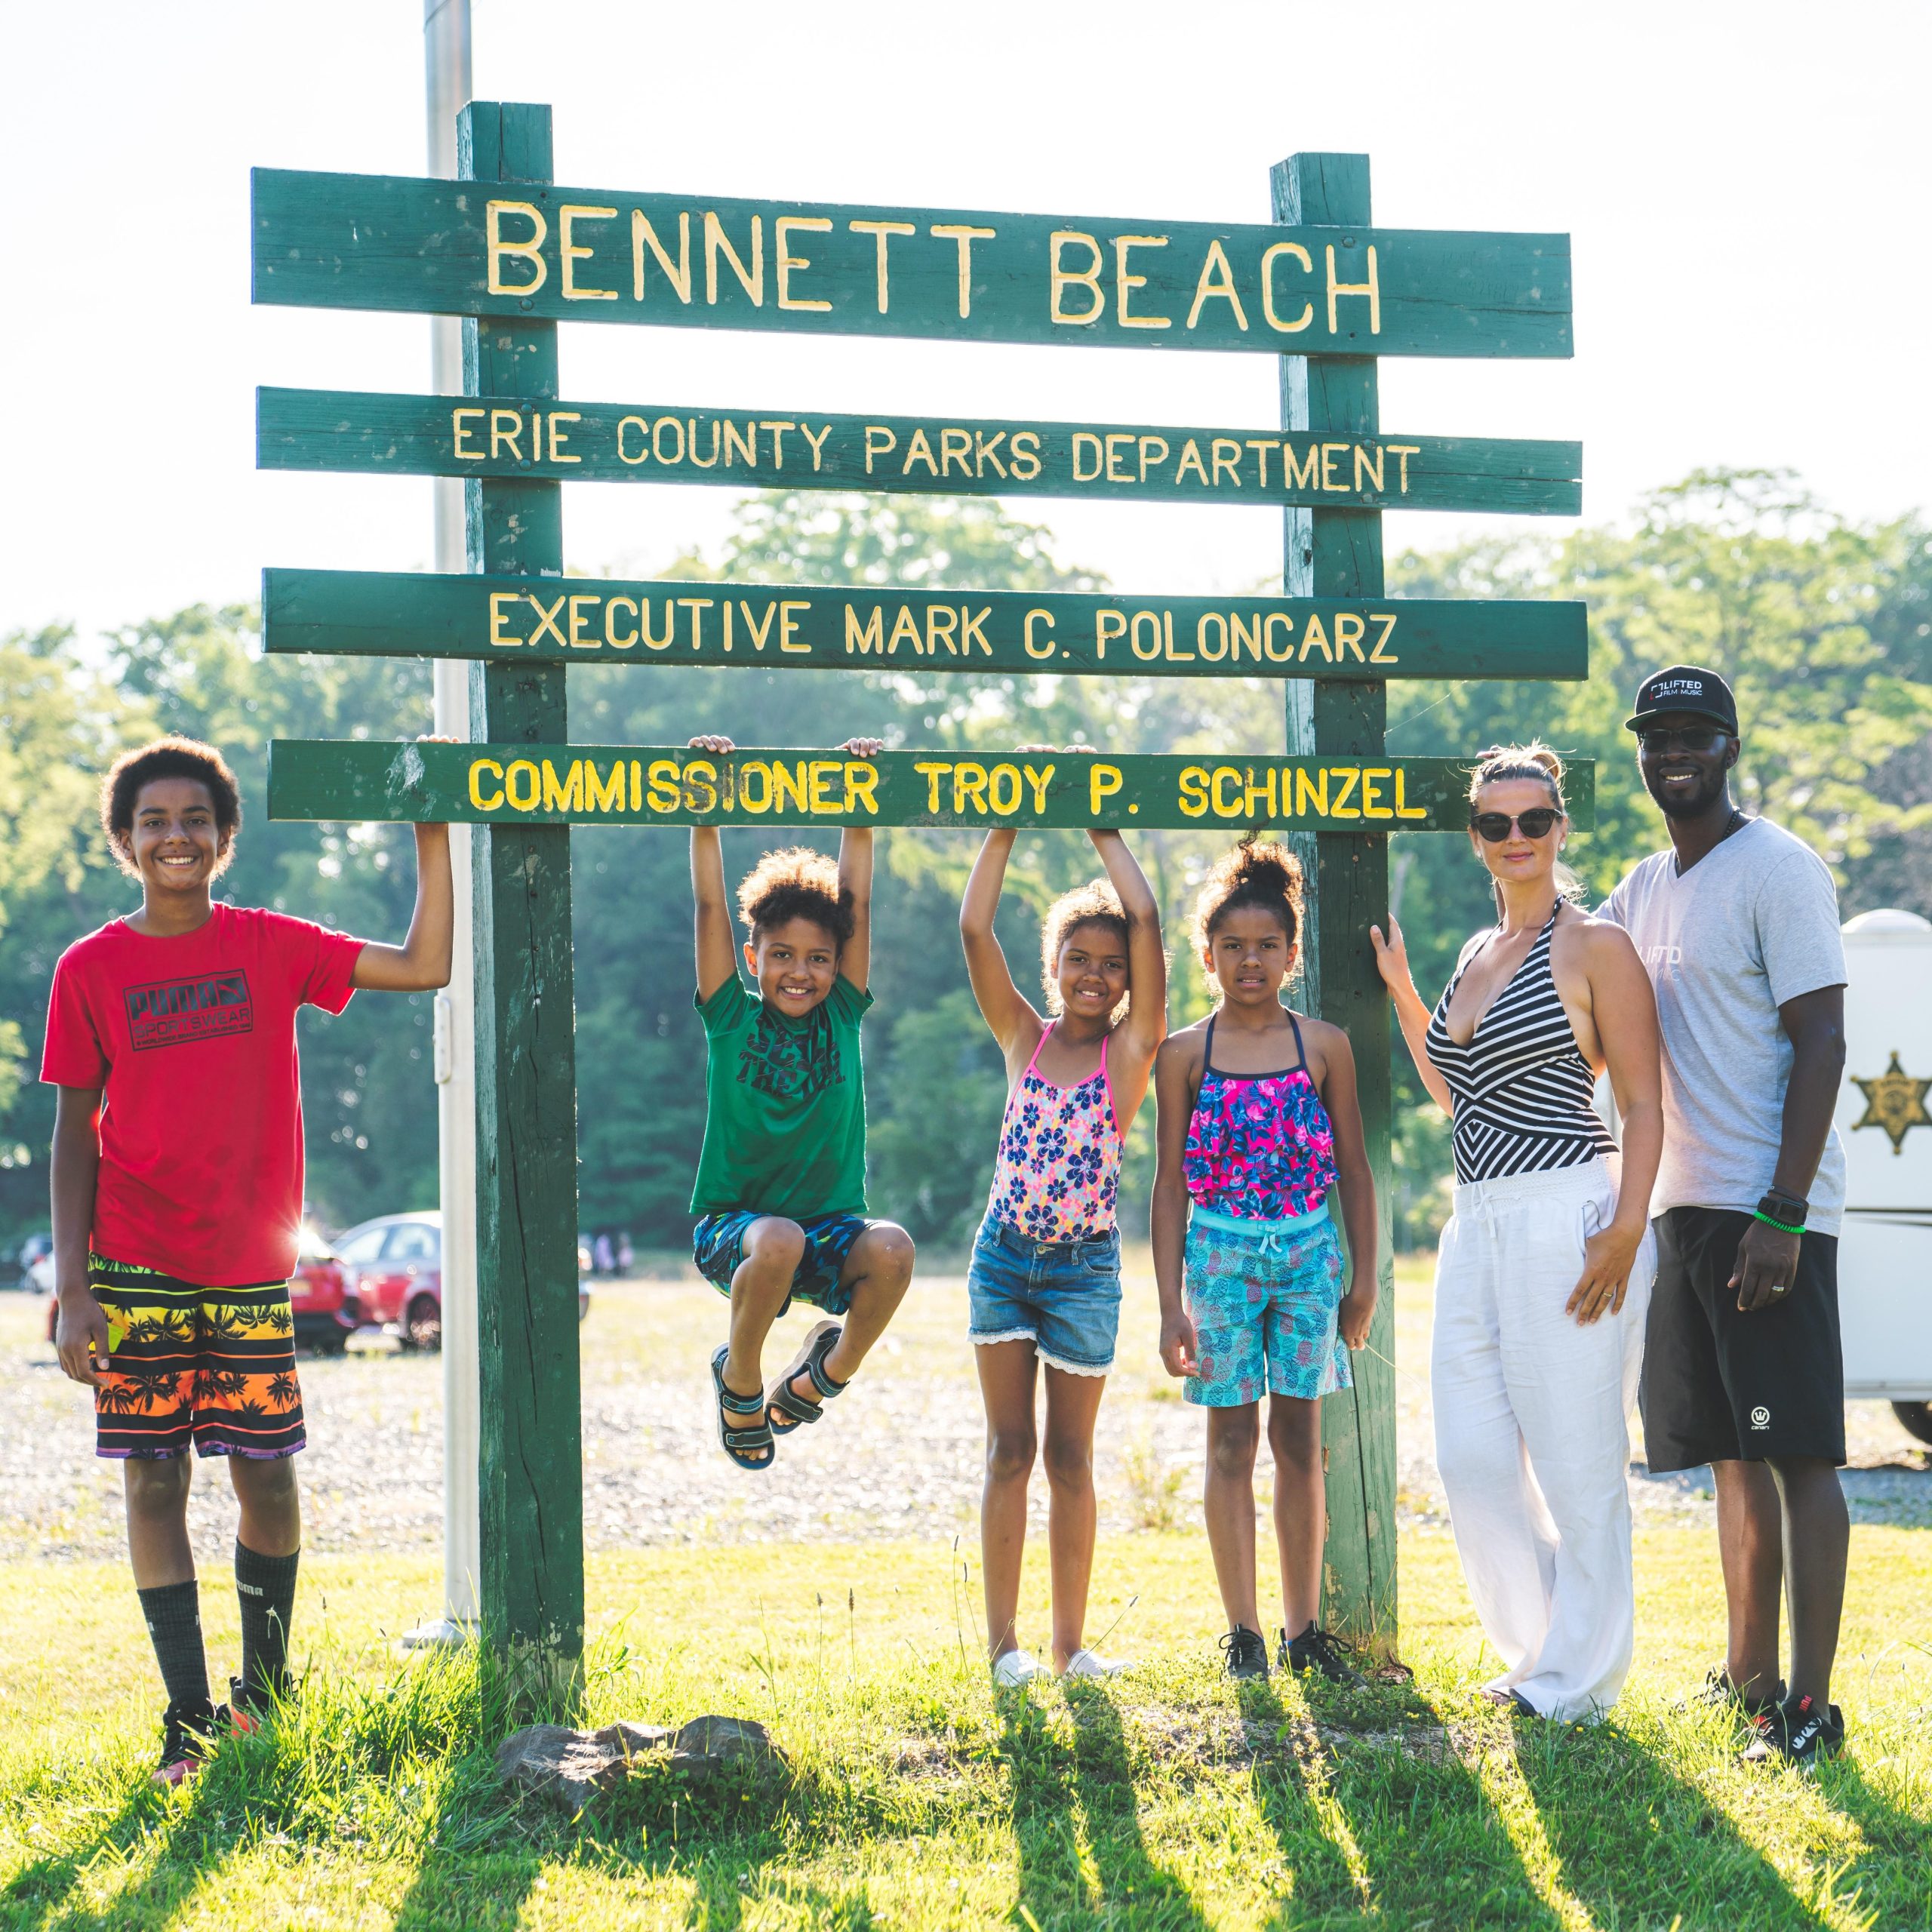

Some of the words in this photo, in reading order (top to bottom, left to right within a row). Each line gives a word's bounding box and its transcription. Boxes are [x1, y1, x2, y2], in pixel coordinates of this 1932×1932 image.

[487, 199, 996, 318] BENNETT
[1050, 232, 1380, 334] BEACH
[453, 408, 582, 463] ERIE
[617, 415, 832, 472] COUNTY
[865, 425, 1041, 481] PARKS
[1072, 432, 1421, 493] DEPARTMENT
[489, 592, 812, 654] EXECUTIVE
[844, 603, 993, 656] MARK
[1023, 608, 1071, 660] C.
[1096, 609, 1398, 663] POLONCARZ
[1663, 680, 1702, 690] LIFTED
[468, 758, 880, 815] COMMISSIONER
[913, 761, 1056, 816] TROY
[1090, 763, 1139, 816] P.
[1178, 765, 1428, 820] SCHINZEL
[128, 980, 218, 1021] PUMA
[134, 1008, 251, 1039] SPORTSWEAR
[236, 1580, 263, 1596] UMA
